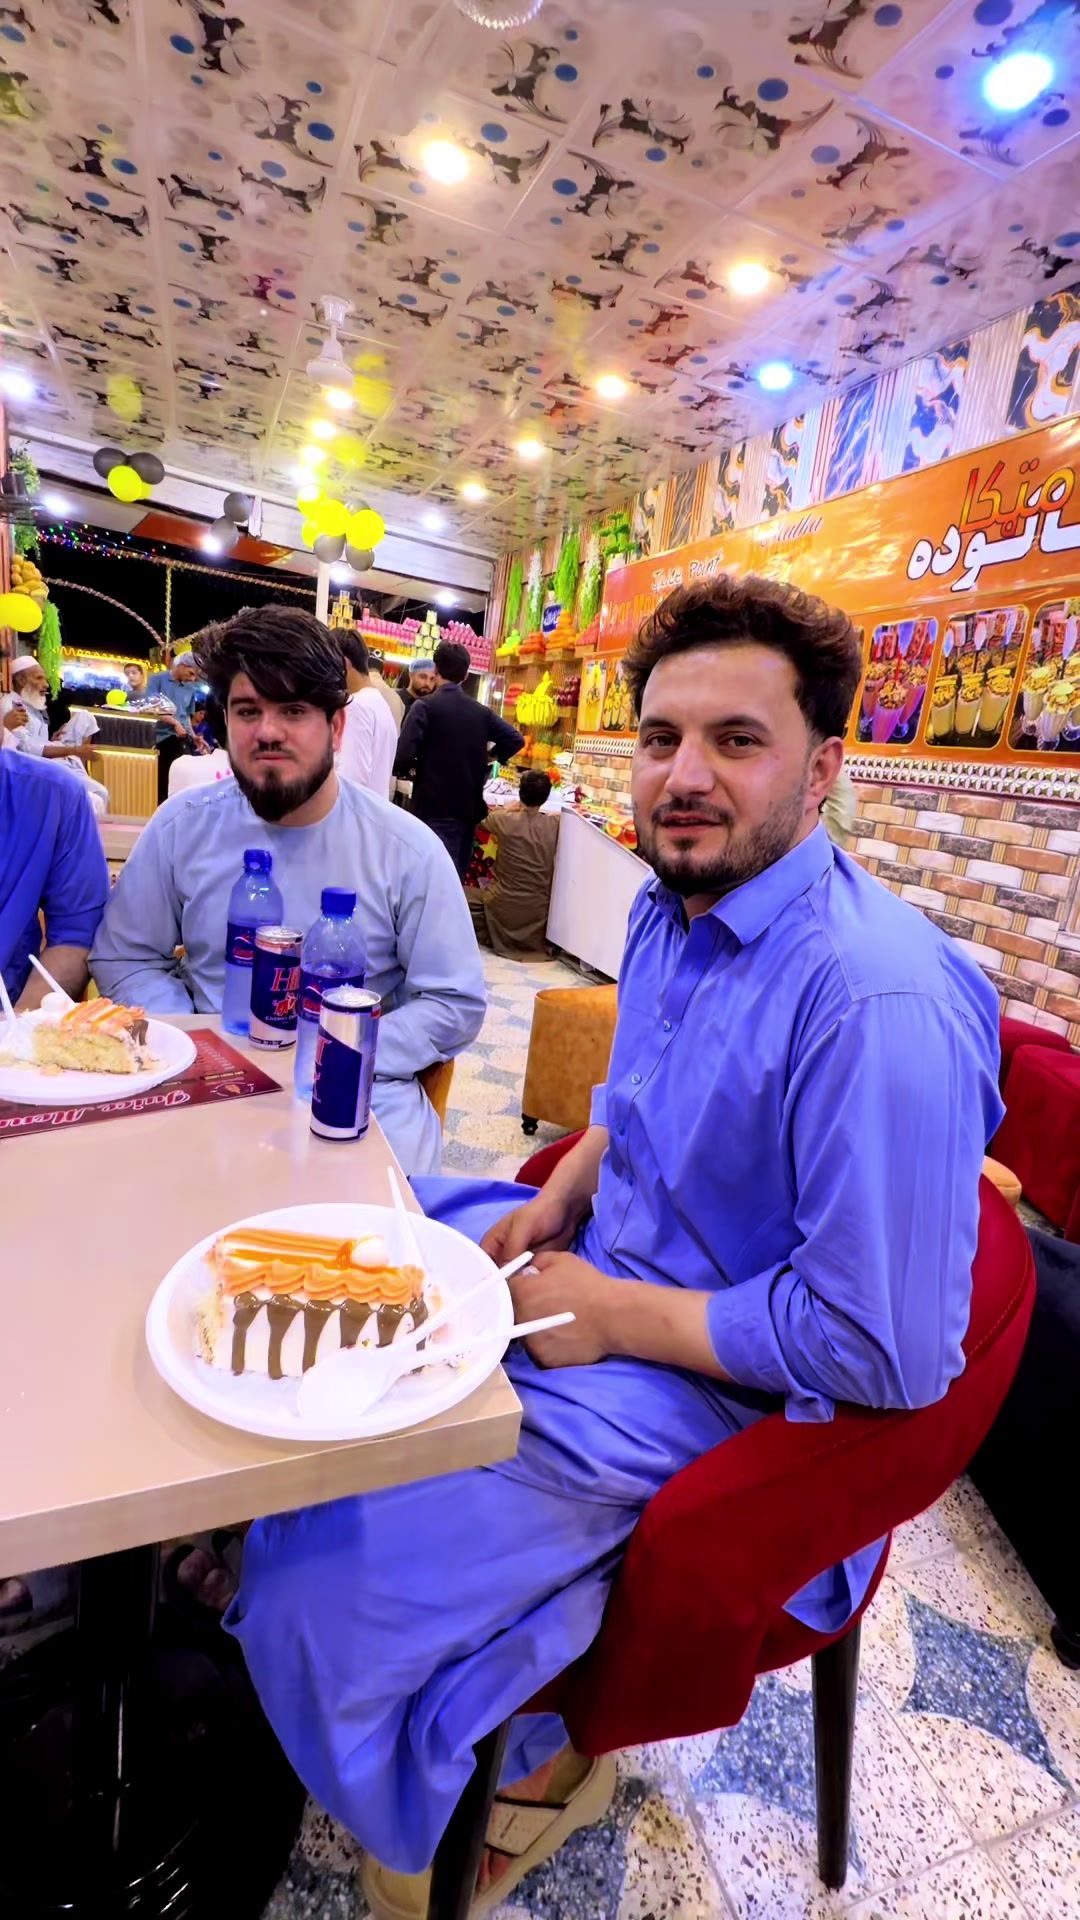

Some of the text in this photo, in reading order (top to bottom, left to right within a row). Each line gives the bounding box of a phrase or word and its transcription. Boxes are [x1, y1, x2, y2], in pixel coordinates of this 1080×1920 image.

[906, 482, 1080, 592] الوده
[651, 549, 724, 592] Juice Point
[97, 1089, 191, 1113] Juice
